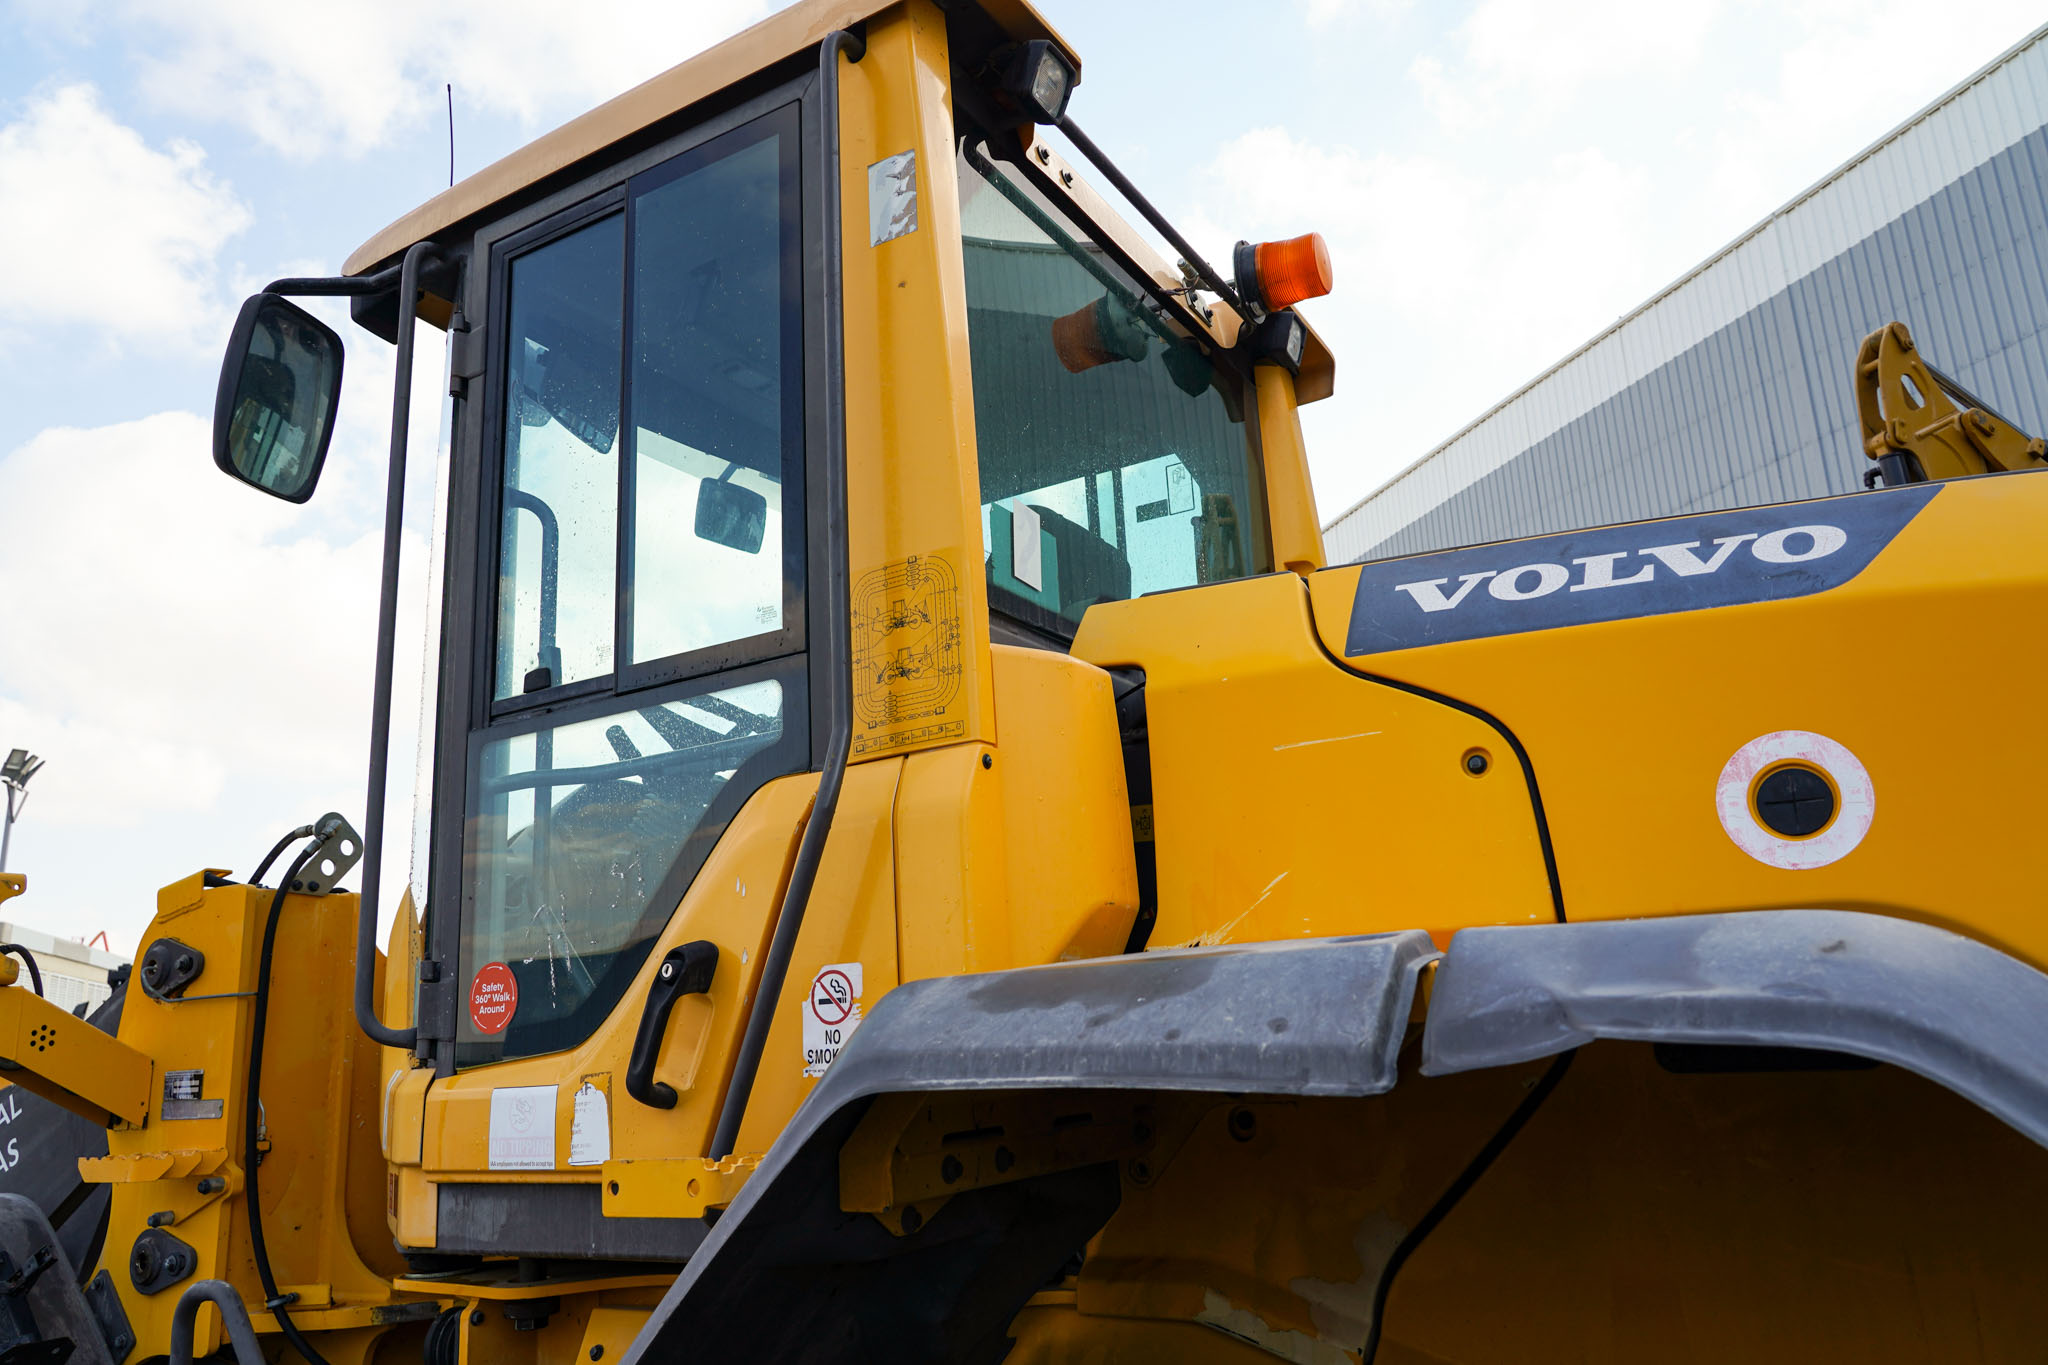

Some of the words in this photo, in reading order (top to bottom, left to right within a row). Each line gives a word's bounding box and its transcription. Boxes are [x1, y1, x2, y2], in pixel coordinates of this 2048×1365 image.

[1395, 525, 1847, 612] VOLVO
[481, 982, 504, 992] Safety
[492, 992, 510, 1002] Walk
[479, 1003, 505, 1014] Around
[825, 1029, 841, 1045] NO
